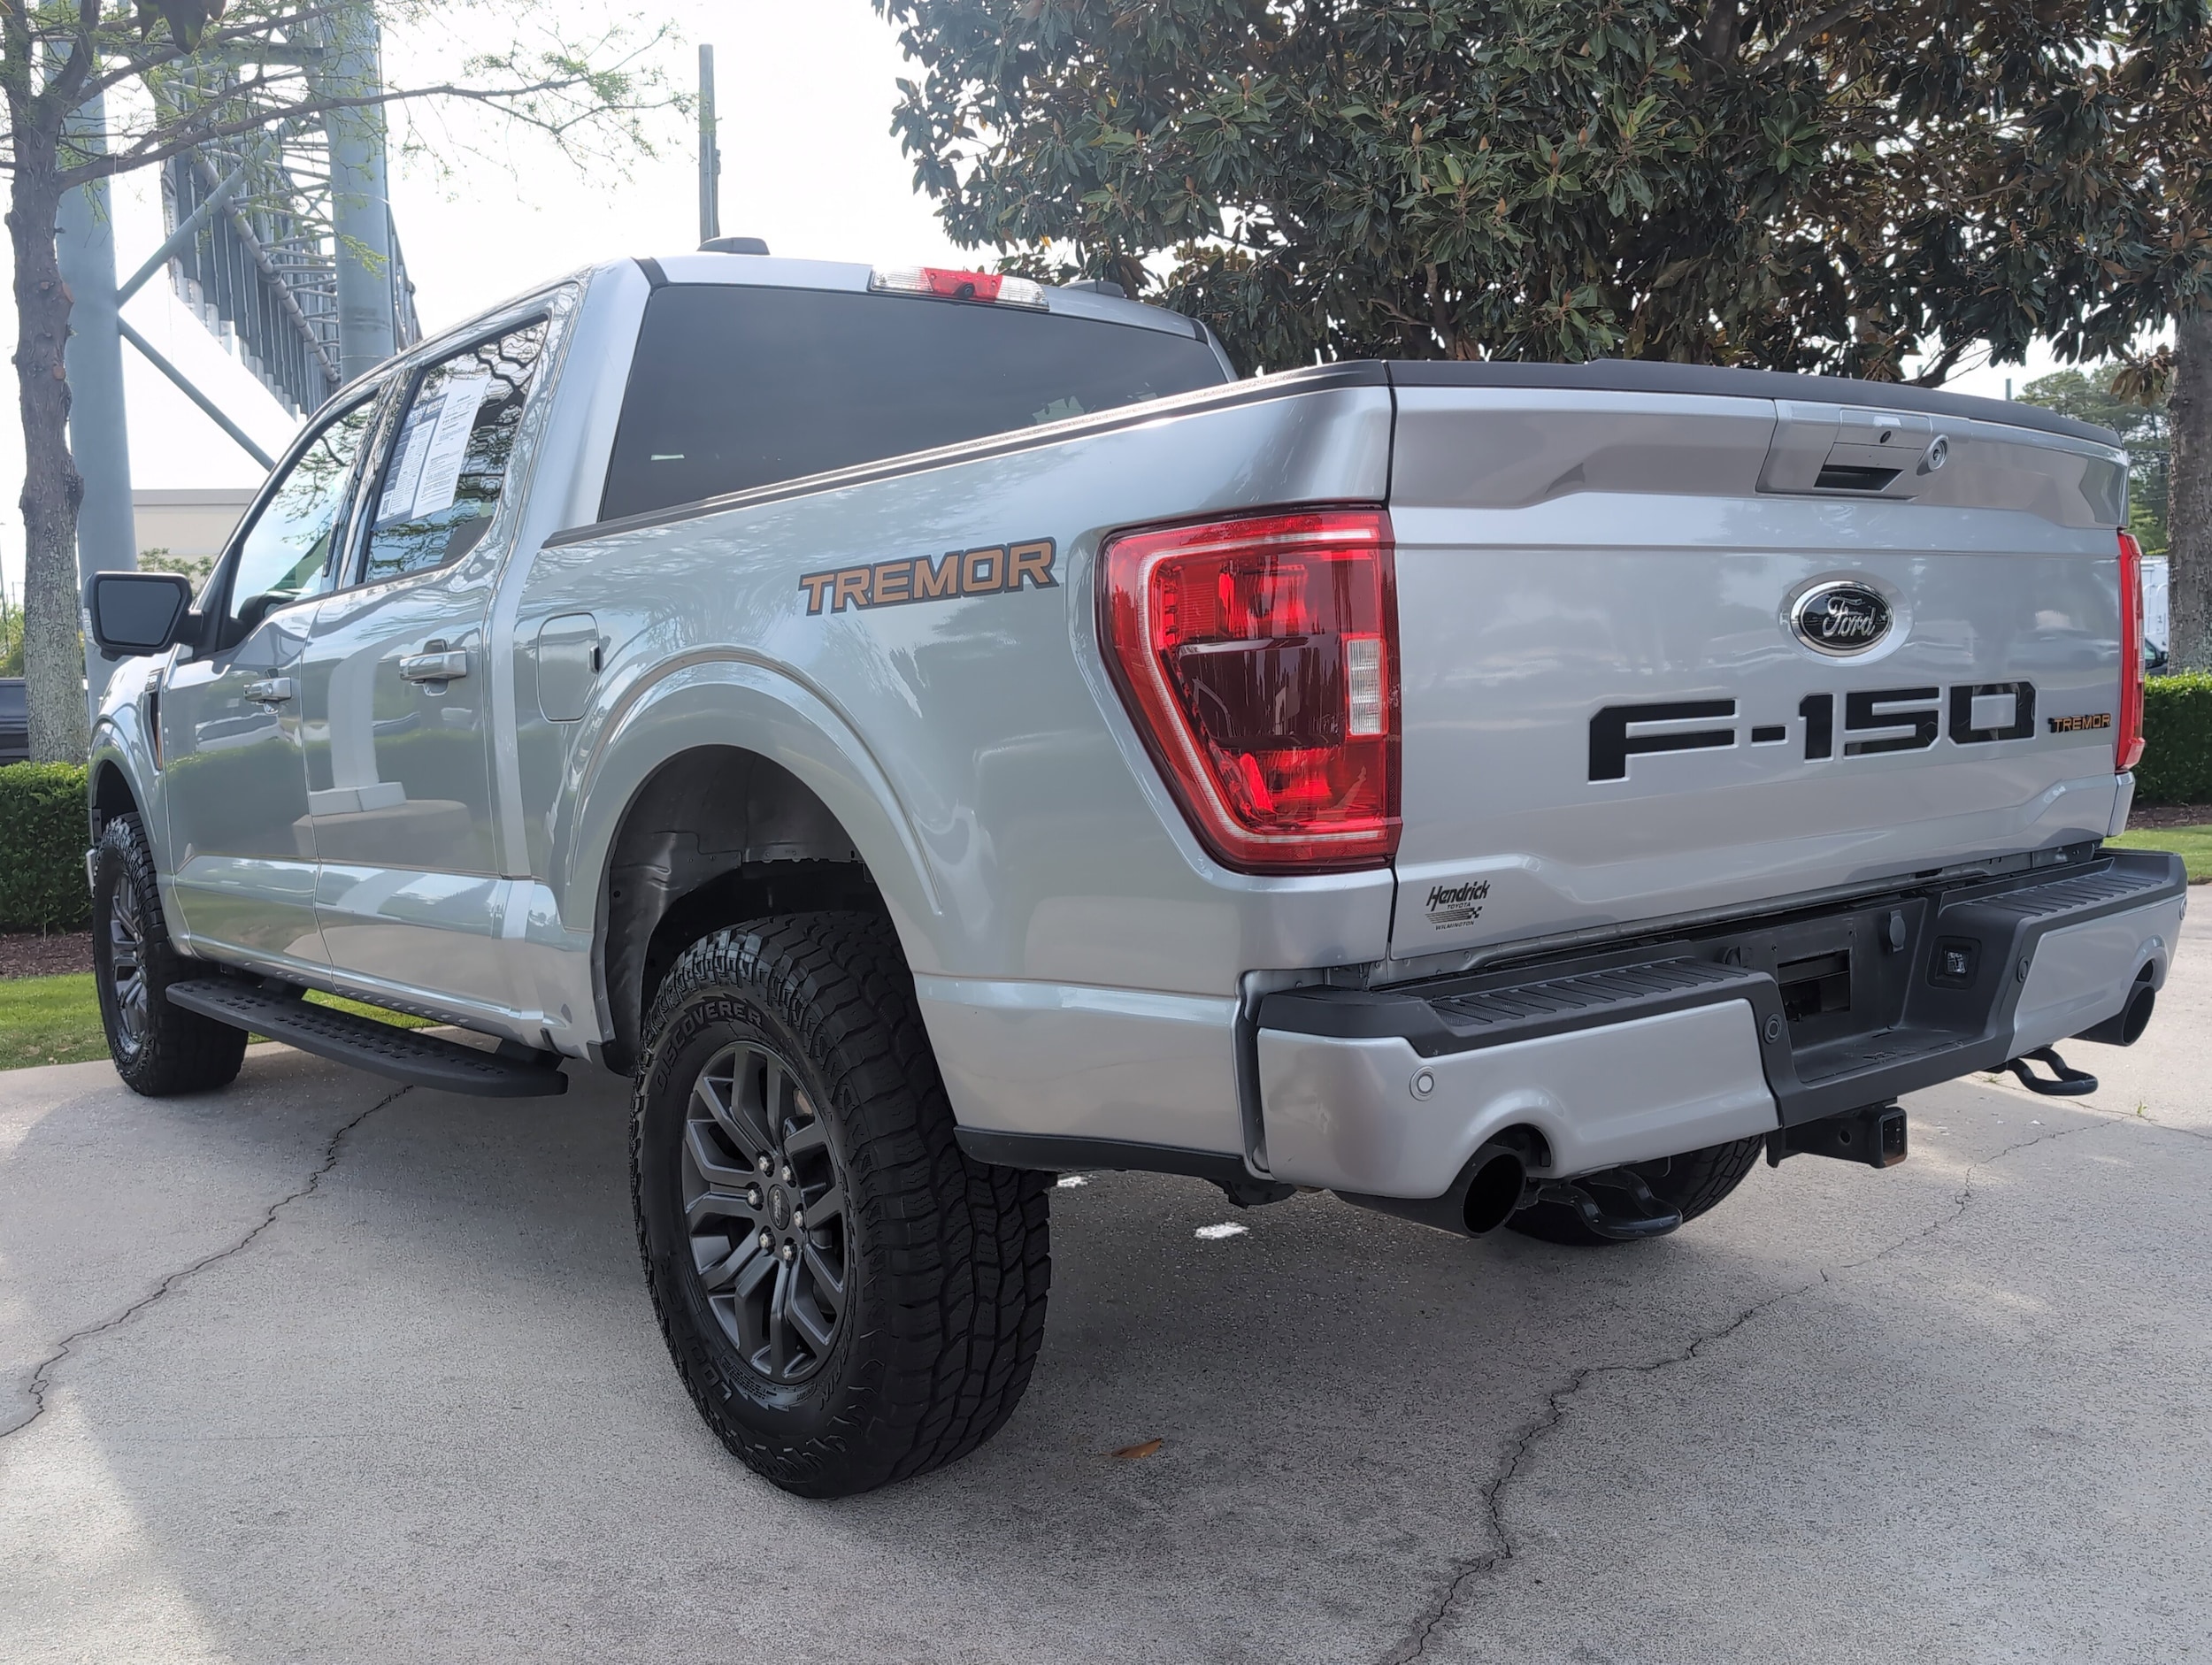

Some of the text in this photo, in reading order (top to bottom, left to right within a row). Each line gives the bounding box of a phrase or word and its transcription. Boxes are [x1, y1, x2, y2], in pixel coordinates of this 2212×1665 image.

[798, 536, 1060, 616] TREMOR
[1822, 596, 1877, 638] Ford
[1588, 680, 2036, 782] F-150
[2048, 712, 2111, 733] TREMOR
[1425, 879, 1491, 912] Hendrick
[1447, 902, 1471, 910] TOYOTA
[656, 999, 764, 1093] DISCOVERER
